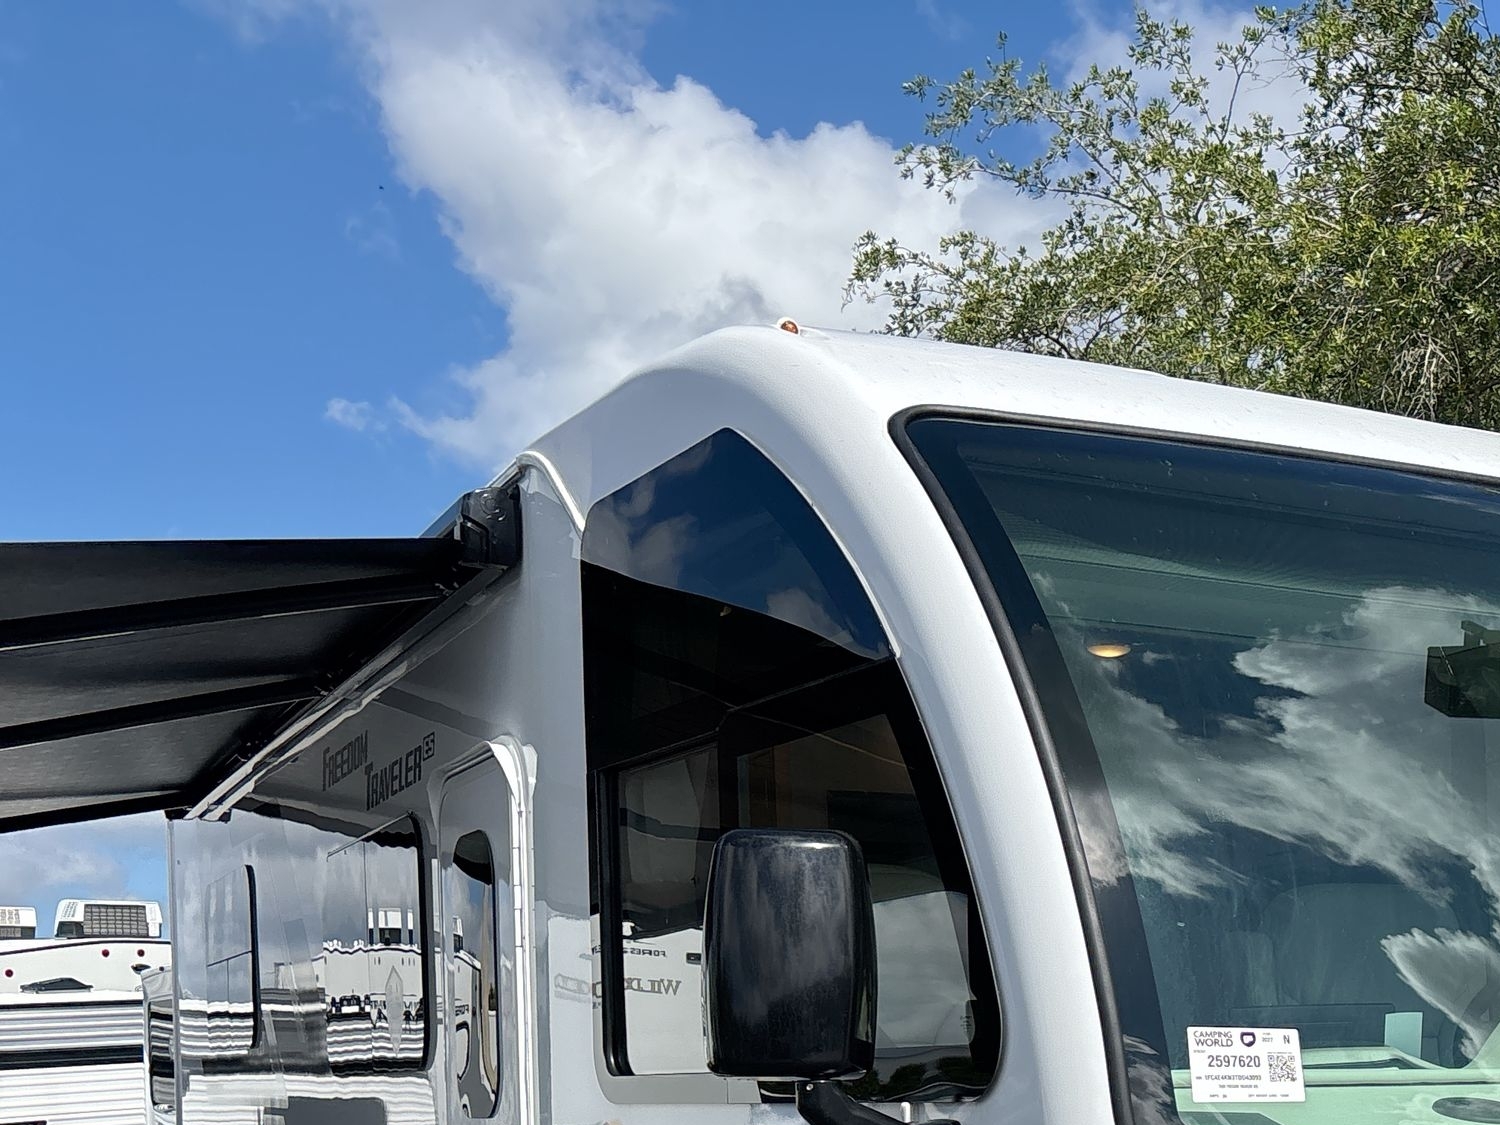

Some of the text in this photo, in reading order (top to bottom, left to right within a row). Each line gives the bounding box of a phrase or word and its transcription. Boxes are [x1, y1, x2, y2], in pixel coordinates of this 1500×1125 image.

[322, 729, 368, 792] FREEDOM
[364, 744, 423, 811] TRAVELER
[1193, 1030, 1233, 1039] CAMPING
[1283, 1034, 1290, 1044] N
[1195, 1038, 1234, 1048] WORLD
[1207, 1054, 1261, 1068] 2597620
